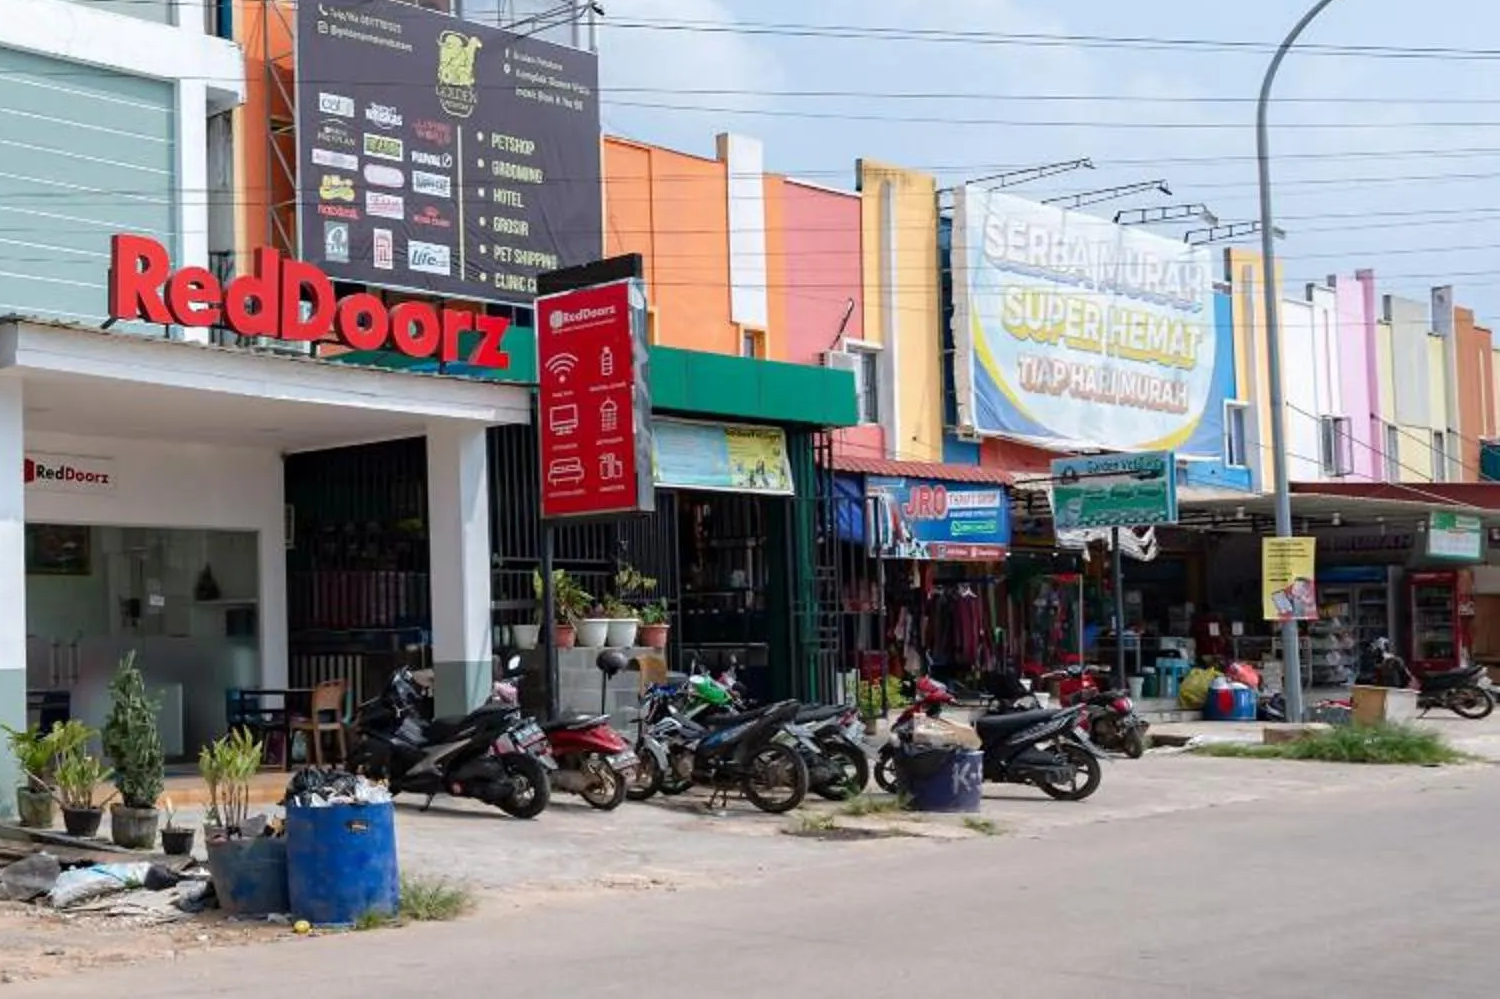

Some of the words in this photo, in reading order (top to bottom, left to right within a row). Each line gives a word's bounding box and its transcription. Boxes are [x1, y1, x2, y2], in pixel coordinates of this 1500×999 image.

[491, 132, 535, 156] PETSHOP
[491, 160, 543, 184] GROOMING
[493, 188, 525, 208] HOTEL
[493, 244, 512, 262] PET
[985, 213, 1092, 282] SERBA
[1097, 240, 1205, 309] MURAH
[110, 233, 511, 370] RedDoorz
[1002, 284, 1101, 344] SUPER
[1107, 305, 1203, 368] HEMAT
[1017, 352, 1067, 395] TIAP
[1120, 372, 1189, 413] MURAH
[36, 464, 109, 484] RedDoorz
[903, 484, 948, 520] JRO
